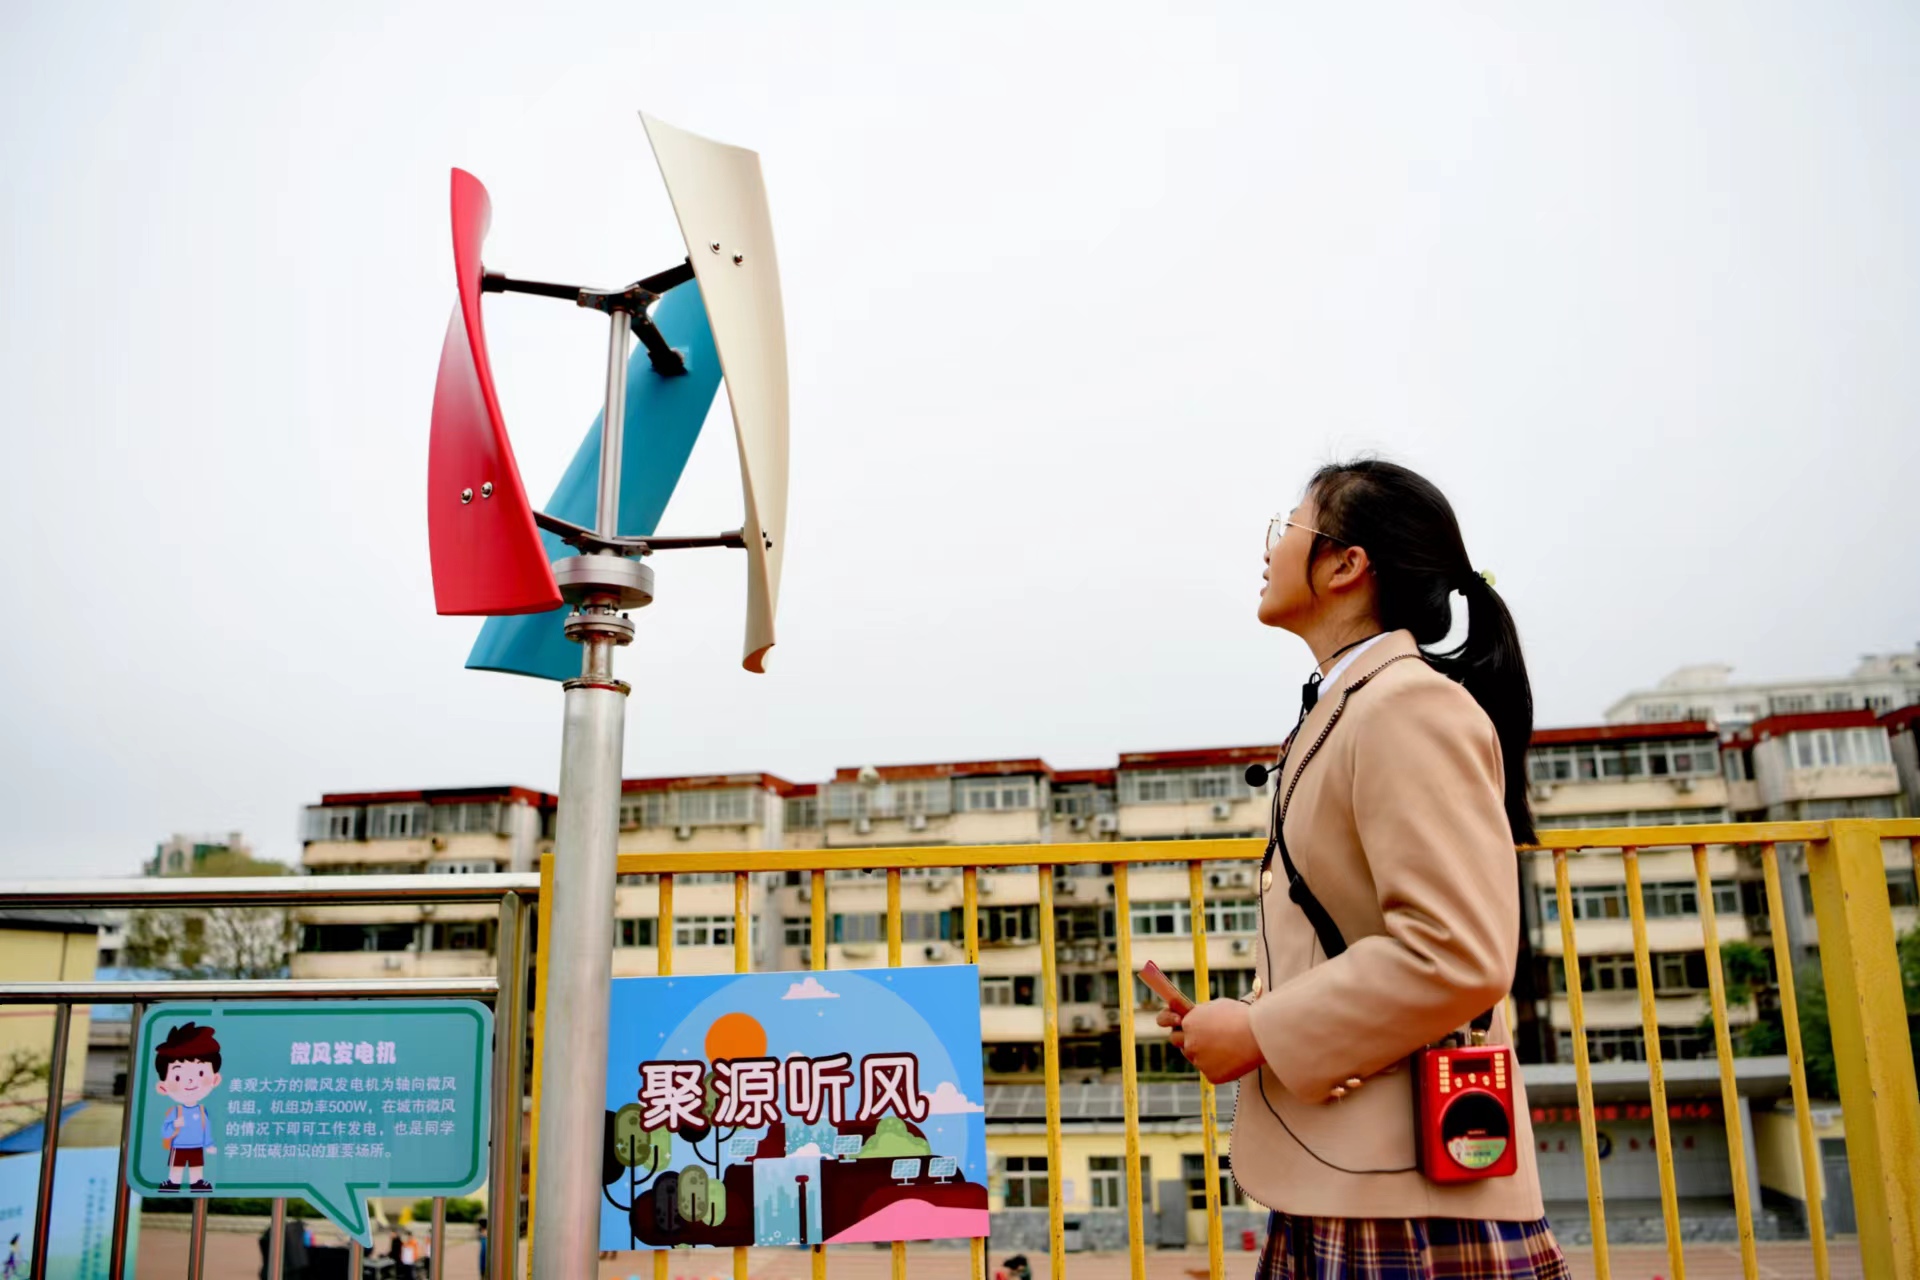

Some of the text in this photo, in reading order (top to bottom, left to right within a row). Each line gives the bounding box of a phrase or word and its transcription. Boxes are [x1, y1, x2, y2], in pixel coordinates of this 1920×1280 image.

[290, 1041, 397, 1065] 微风发电机
[229, 1077, 457, 1093] 美观大方的微风发电机为轴向微风
[639, 1053, 928, 1131] 聚源听风
